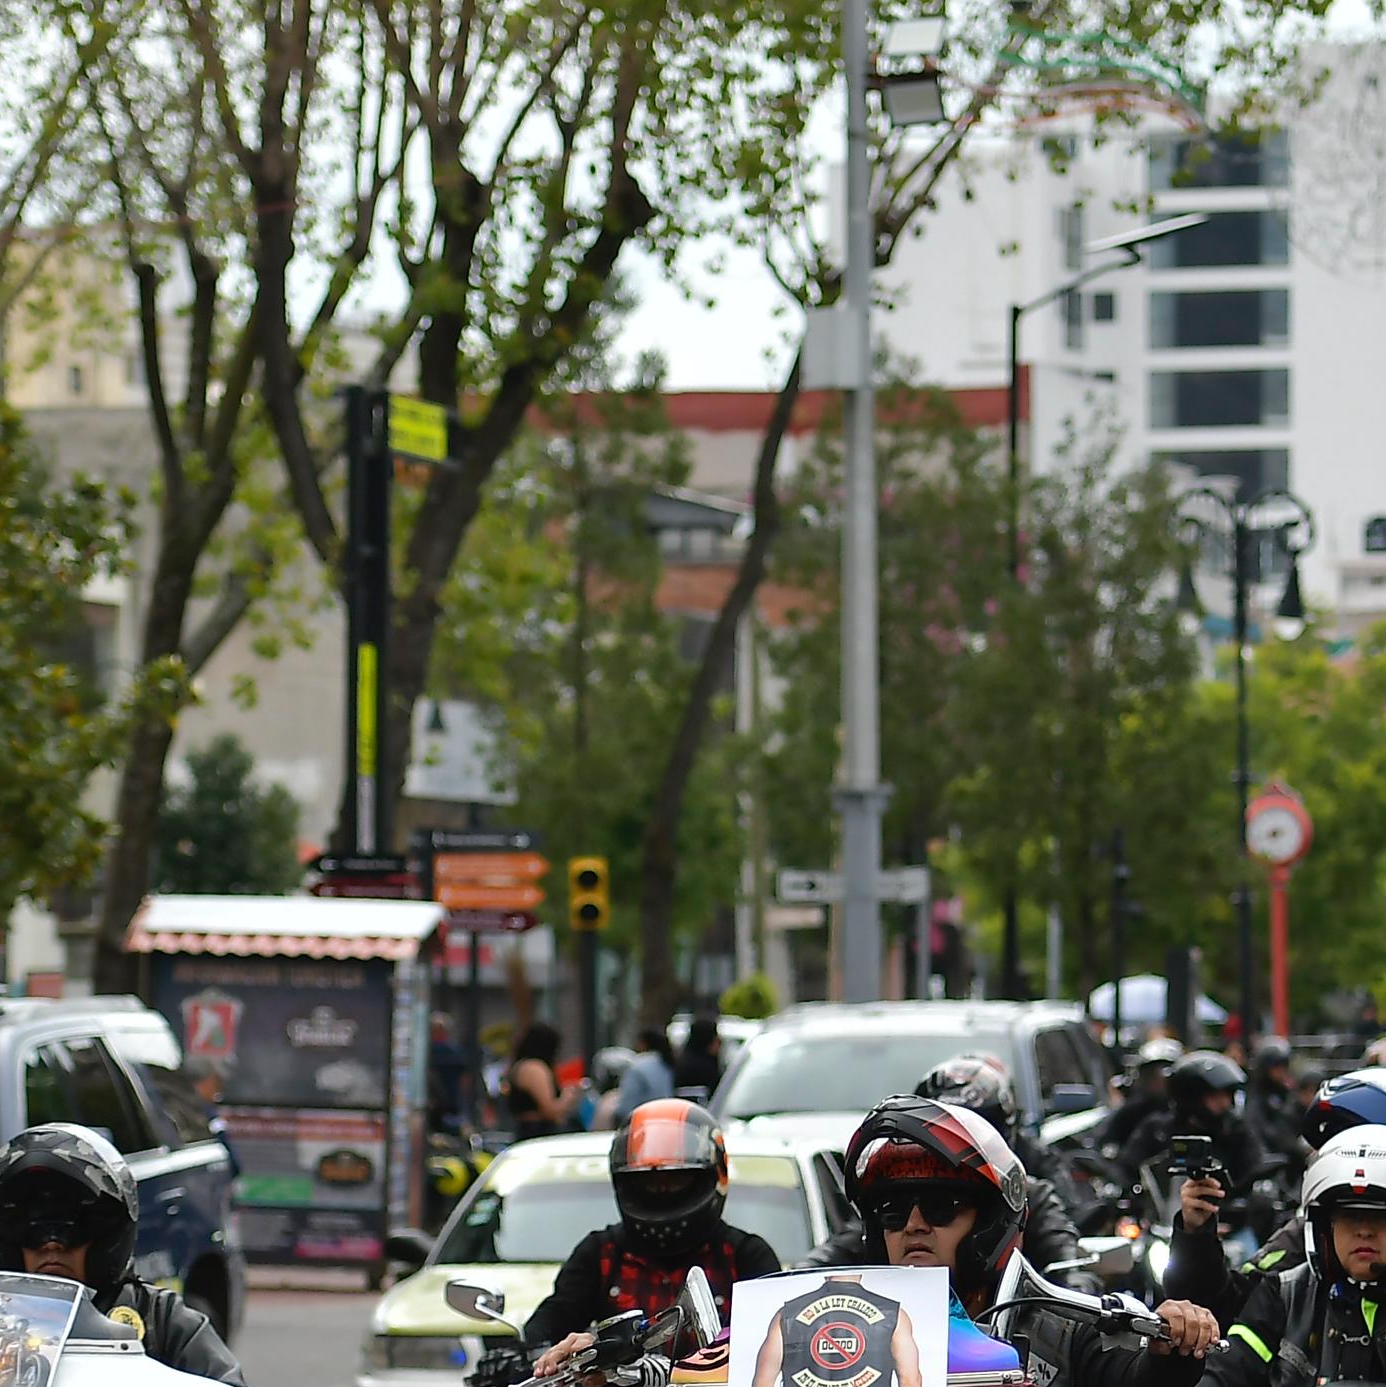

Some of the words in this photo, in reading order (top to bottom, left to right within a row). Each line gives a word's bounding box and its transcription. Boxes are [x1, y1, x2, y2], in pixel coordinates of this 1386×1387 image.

[820, 1299, 830, 1310] LA
[831, 1298, 845, 1308] LEY
[847, 1299, 877, 1319] CHALECO
